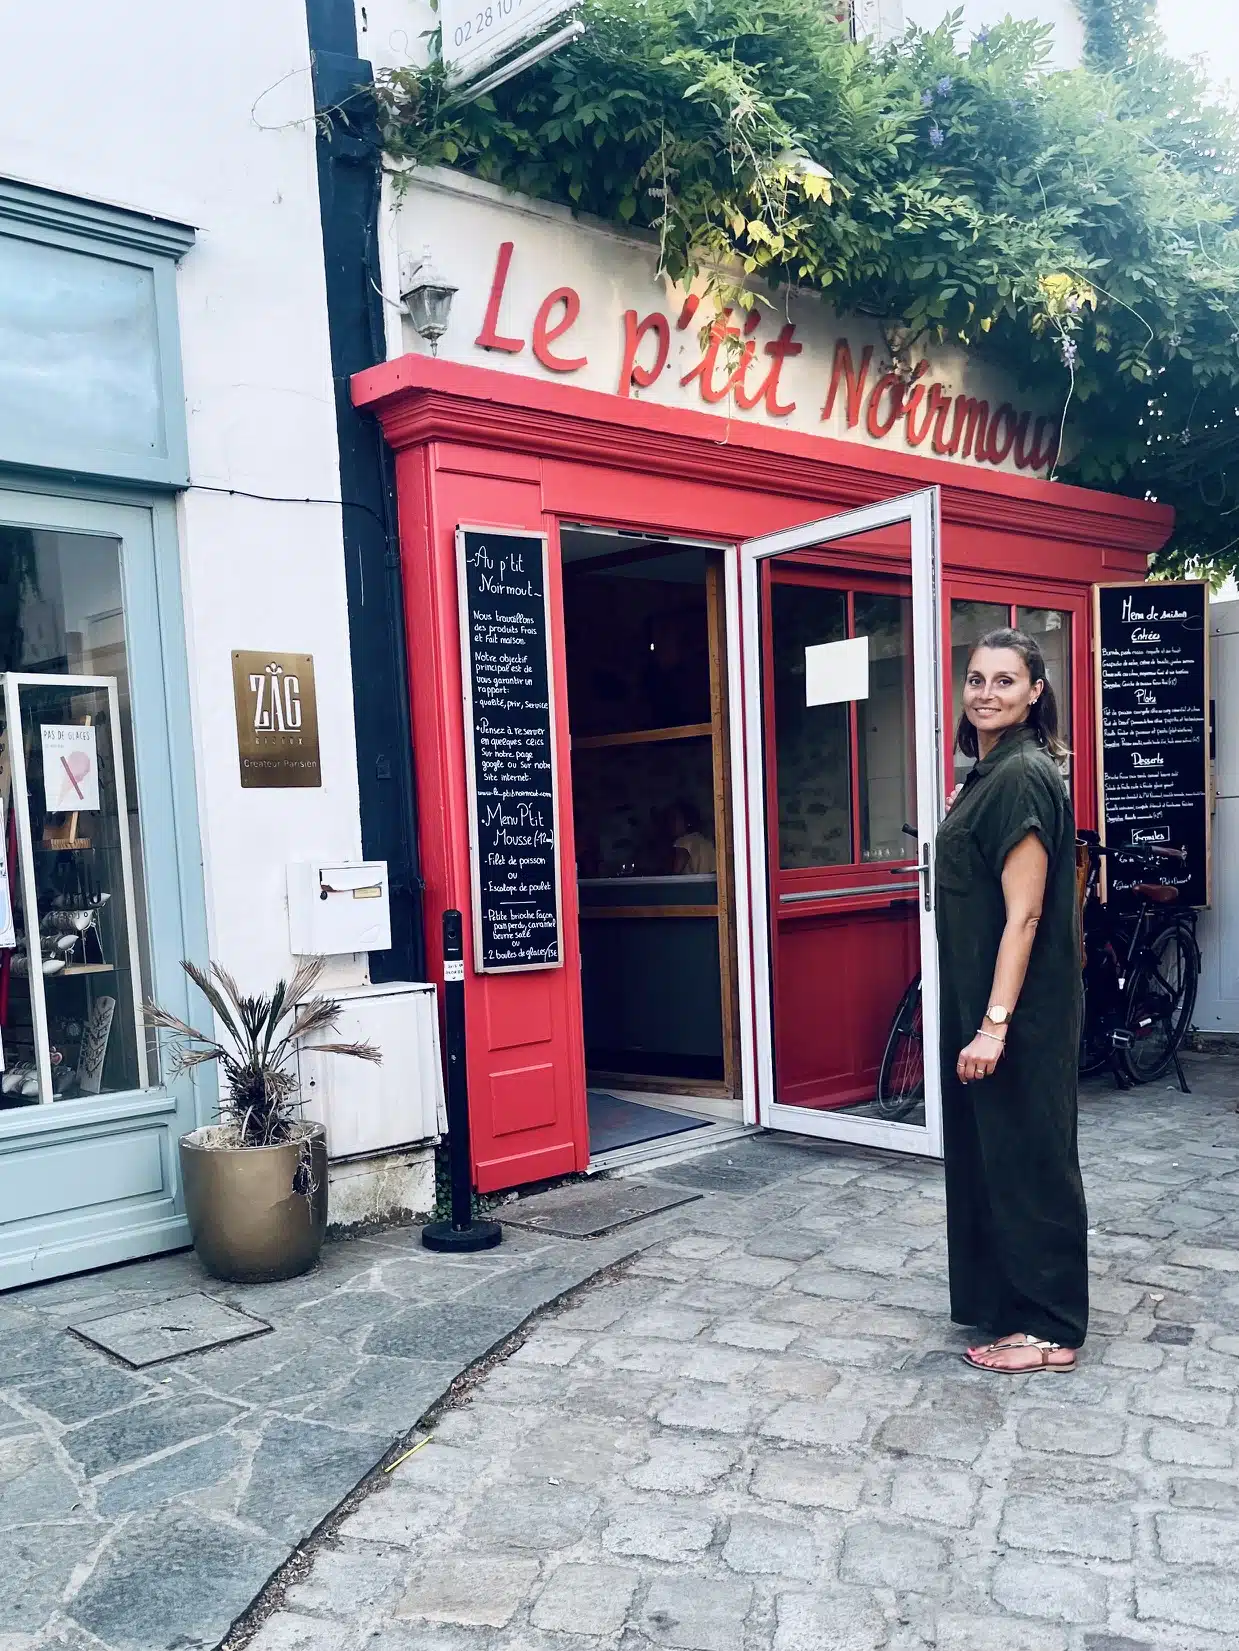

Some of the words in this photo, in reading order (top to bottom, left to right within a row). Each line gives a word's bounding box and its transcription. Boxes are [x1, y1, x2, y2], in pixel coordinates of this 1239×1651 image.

[455, 21, 472, 46] 02
[476, 7, 492, 34] 28
[474, 241, 588, 372] Le
[618, 294, 803, 416] p'tit
[500, 553, 524, 582] p'tit
[479, 574, 532, 596] Noirmout
[473, 610, 492, 620] Nous
[495, 610, 534, 624] travaillons
[1146, 606, 1158, 620] de
[1160, 610, 1188, 620] saison
[489, 625, 518, 636] produits
[1131, 628, 1160, 640] Entrées
[474, 634, 483, 642] et
[475, 652, 497, 662] Notre
[499, 654, 528, 665] objectif
[476, 664, 510, 674] principal
[493, 676, 524, 687] garantir
[1134, 688, 1156, 702] Plats
[249, 674, 302, 730] ZAG
[480, 717, 506, 734] Pensez
[507, 726, 513, 734] à
[44, 730, 55, 740] PAS
[58, 730, 64, 740] DE
[68, 732, 90, 740] GLACES
[491, 738, 522, 750] quelques
[526, 738, 544, 746] clics
[516, 751, 534, 761] page
[1131, 752, 1164, 765] Desserts
[284, 760, 316, 768] Parisien
[482, 760, 504, 772] google
[485, 802, 518, 826] Menu
[517, 802, 544, 826] P'tit
[493, 828, 532, 846] Mousse
[488, 853, 506, 865] Filet
[508, 855, 518, 865] de
[520, 858, 546, 869] poisson
[488, 881, 518, 895] Escalope
[519, 882, 528, 892] de
[529, 881, 551, 895] poulet
[488, 909, 508, 921] Petite
[510, 909, 535, 920] brioche
[494, 924, 508, 933] pain
[528, 918, 556, 928] caramel
[493, 931, 514, 940] beurre
[515, 929, 532, 938] salé
[488, 950, 494, 960] 2
[496, 950, 517, 959] boules
[518, 948, 526, 957] de
[526, 947, 546, 960] glaces
